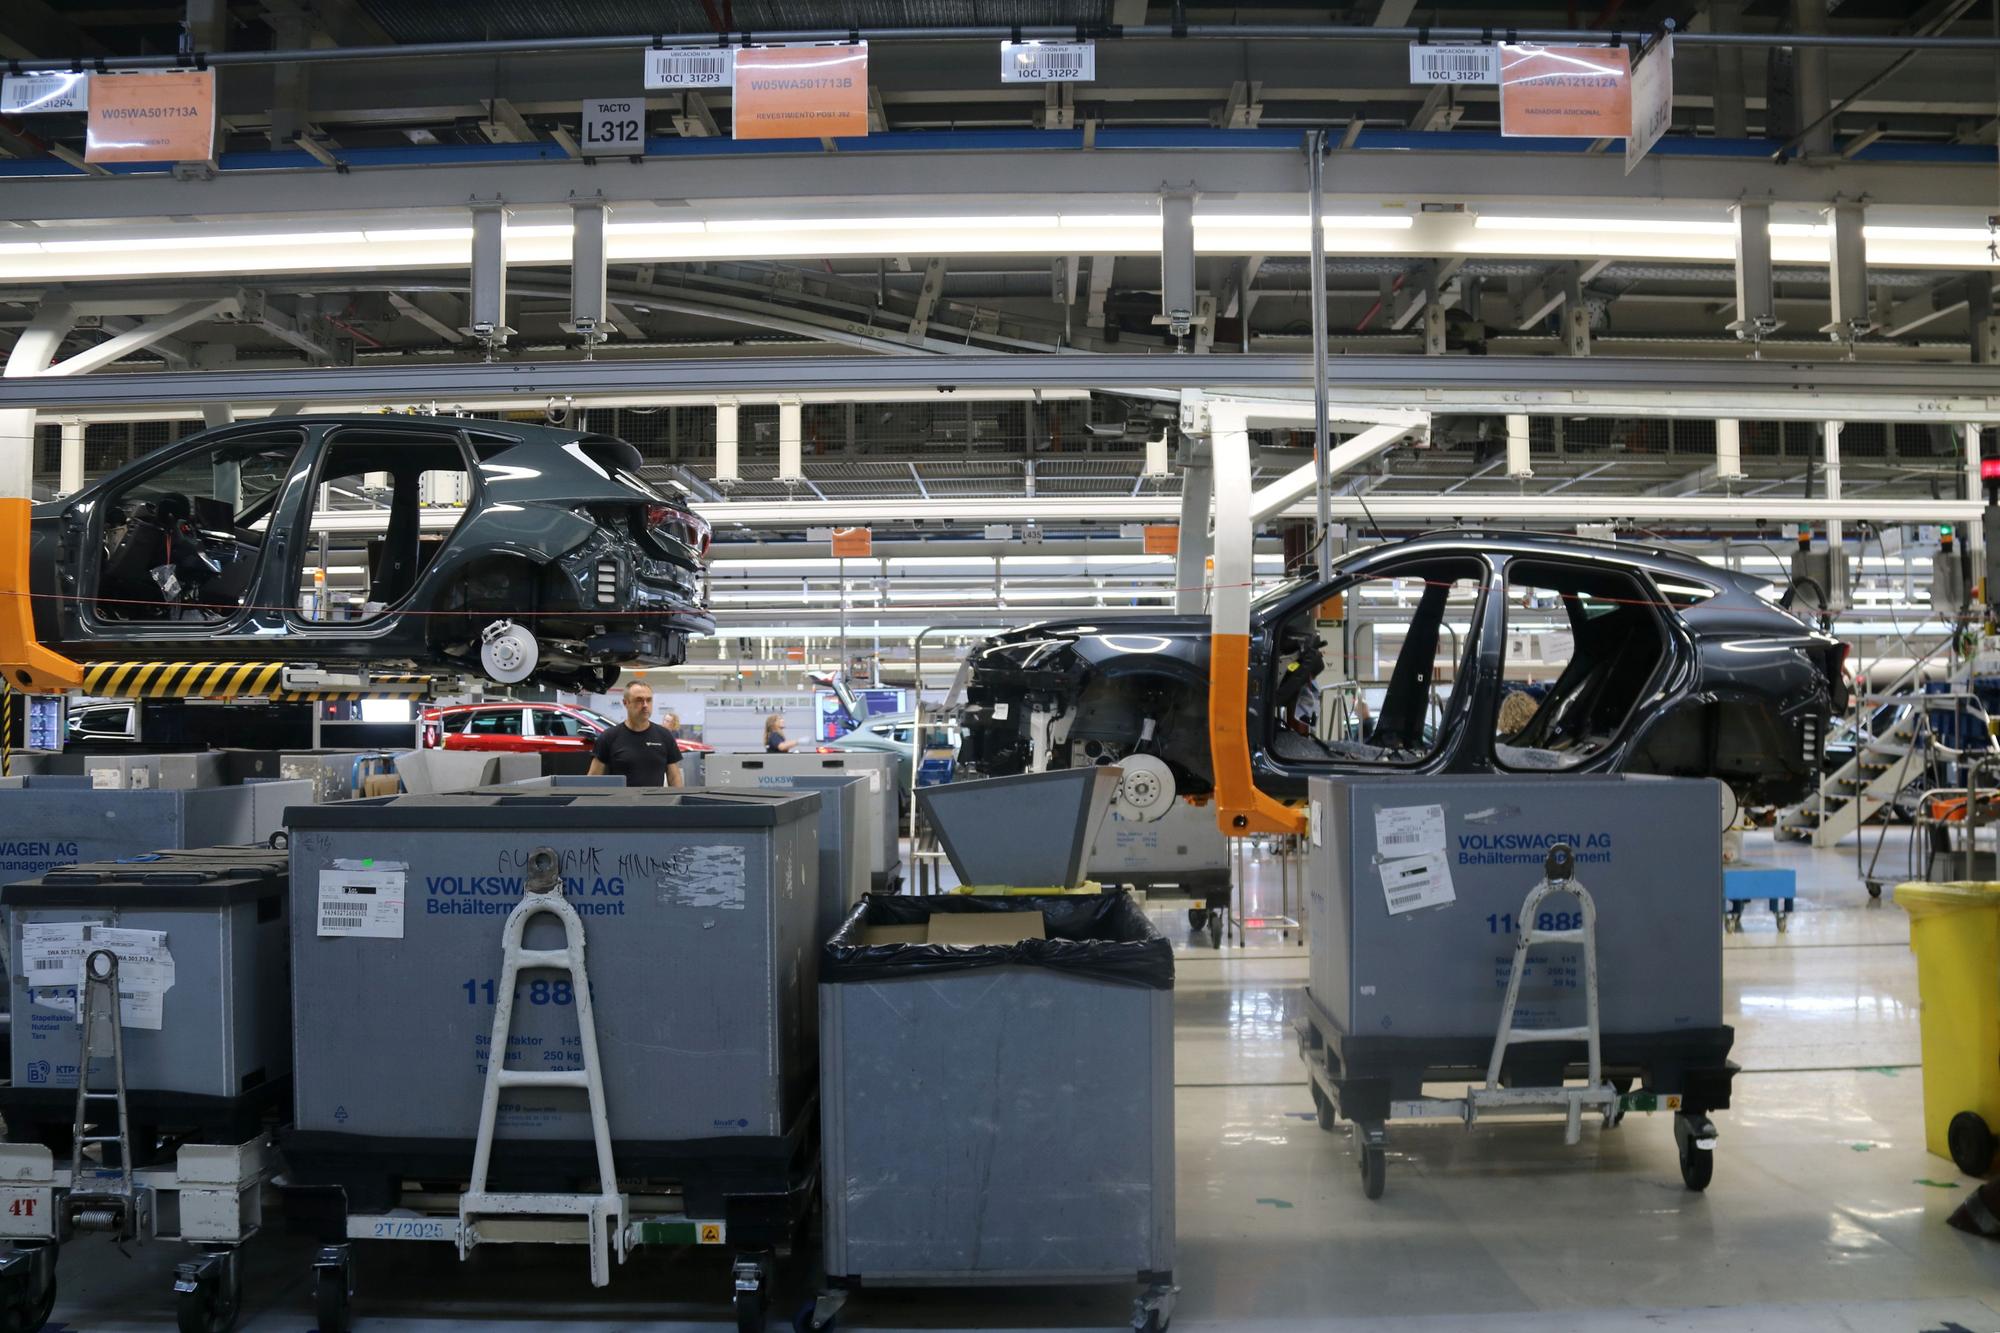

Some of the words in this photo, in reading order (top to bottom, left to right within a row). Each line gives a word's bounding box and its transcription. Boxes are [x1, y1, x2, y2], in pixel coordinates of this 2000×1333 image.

[751, 78, 852, 90] W05WA501713B
[102, 107, 198, 119] W05WA501713A
[598, 103, 631, 112] TACTO
[588, 120, 639, 142] L312
[1586, 834, 1611, 848] AG
[55, 842, 79, 856] AG
[426, 877, 583, 895] VOLKSWEN
[592, 877, 624, 896] AG
[427, 898, 624, 915] Behältermment
[1486, 913, 1520, 933] 11
[463, 979, 520, 1005] 11
[530, 979, 595, 1005] 88
[475, 1035, 542, 1045] Stalfaktor
[476, 1050, 522, 1060] Nuast
[544, 1051, 563, 1060] 250
[567, 1050, 580, 1062] kg
[9, 1199, 37, 1216] 4T
[374, 1223, 444, 1238] 2T/2025
